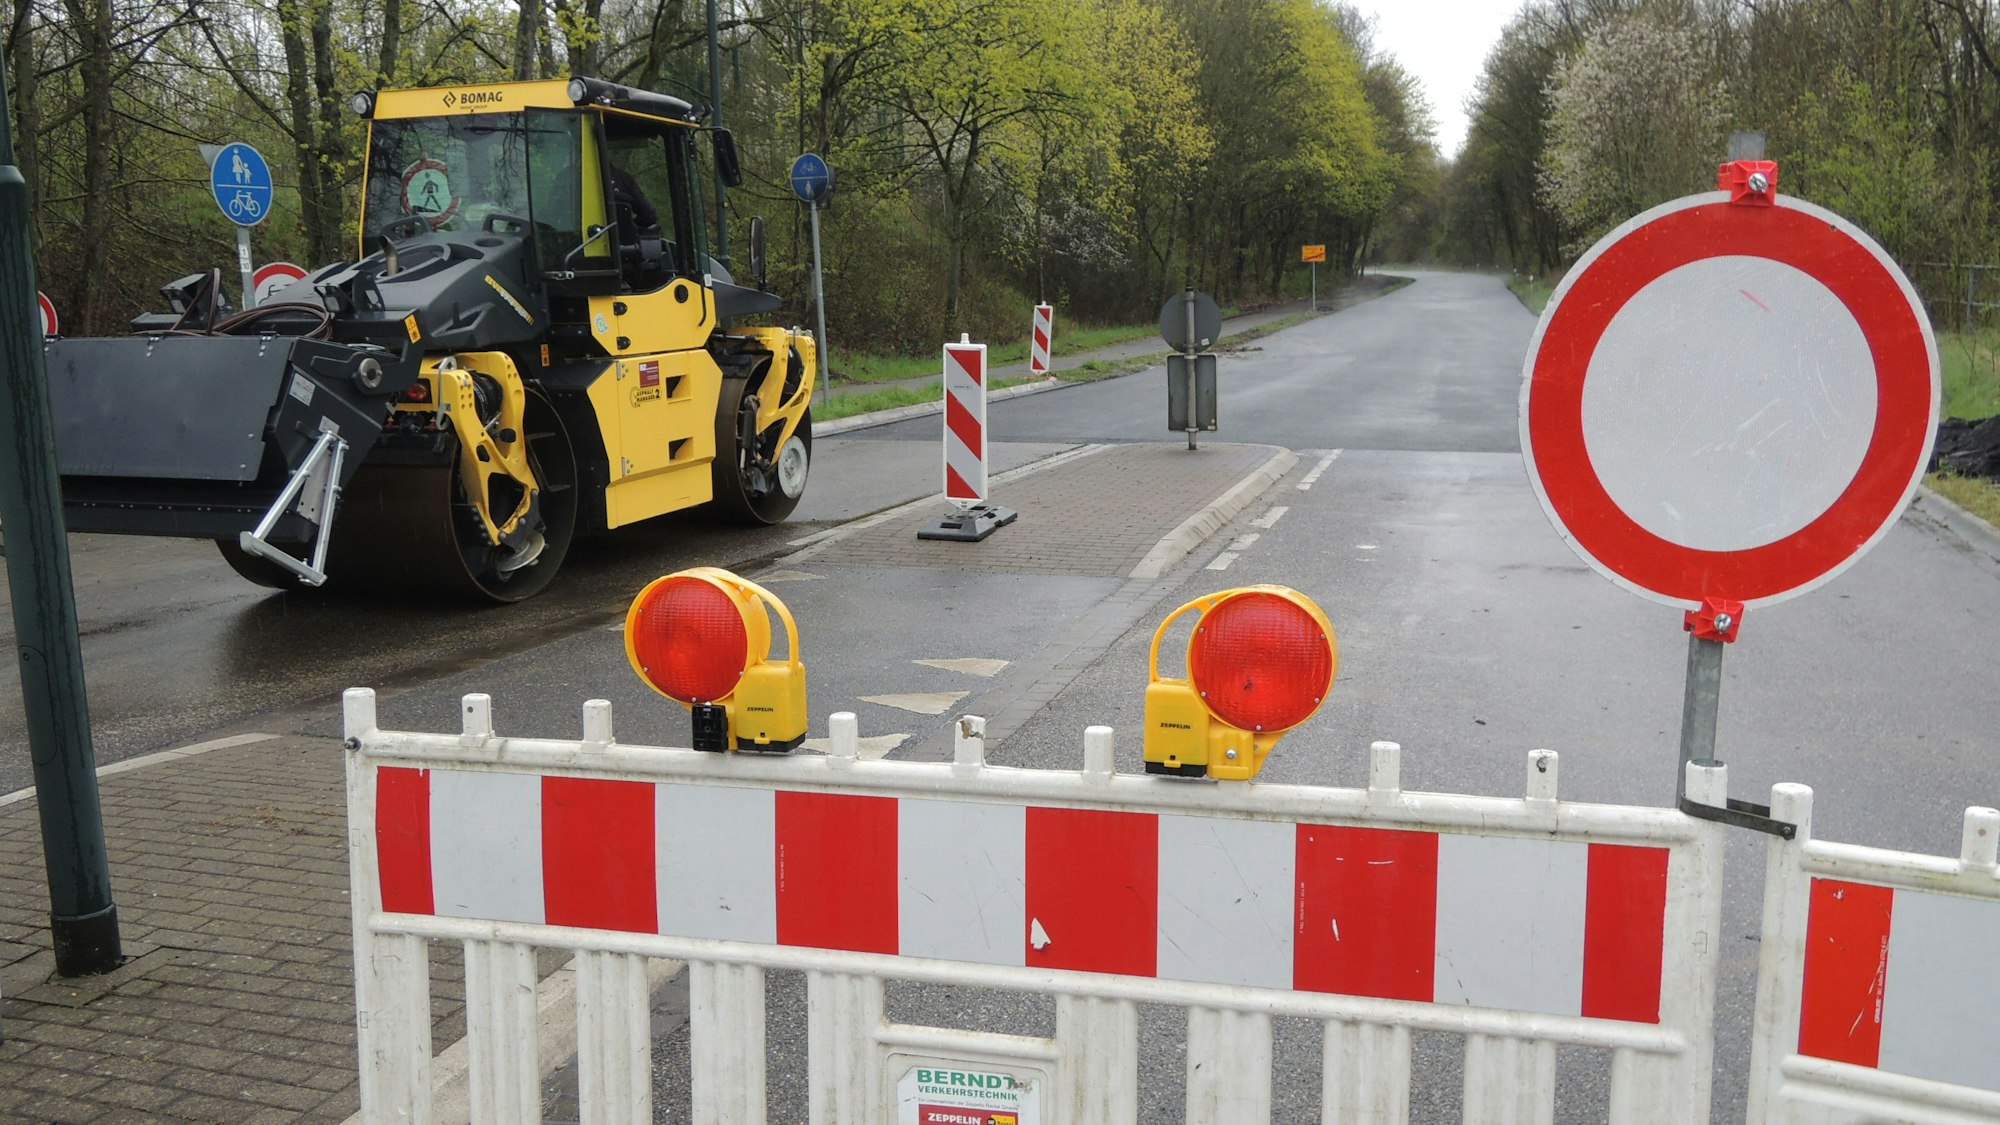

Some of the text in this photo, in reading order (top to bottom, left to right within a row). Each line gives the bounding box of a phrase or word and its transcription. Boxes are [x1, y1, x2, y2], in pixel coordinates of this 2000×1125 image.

[461, 91, 503, 104] BOMAG
[1160, 722, 1191, 730] ZEPPELIN
[917, 1070, 1016, 1090] BERNDT
[918, 1085, 1018, 1102] VERKEHRSTECHNIK
[928, 1112, 981, 1125] ZEPPELIN
